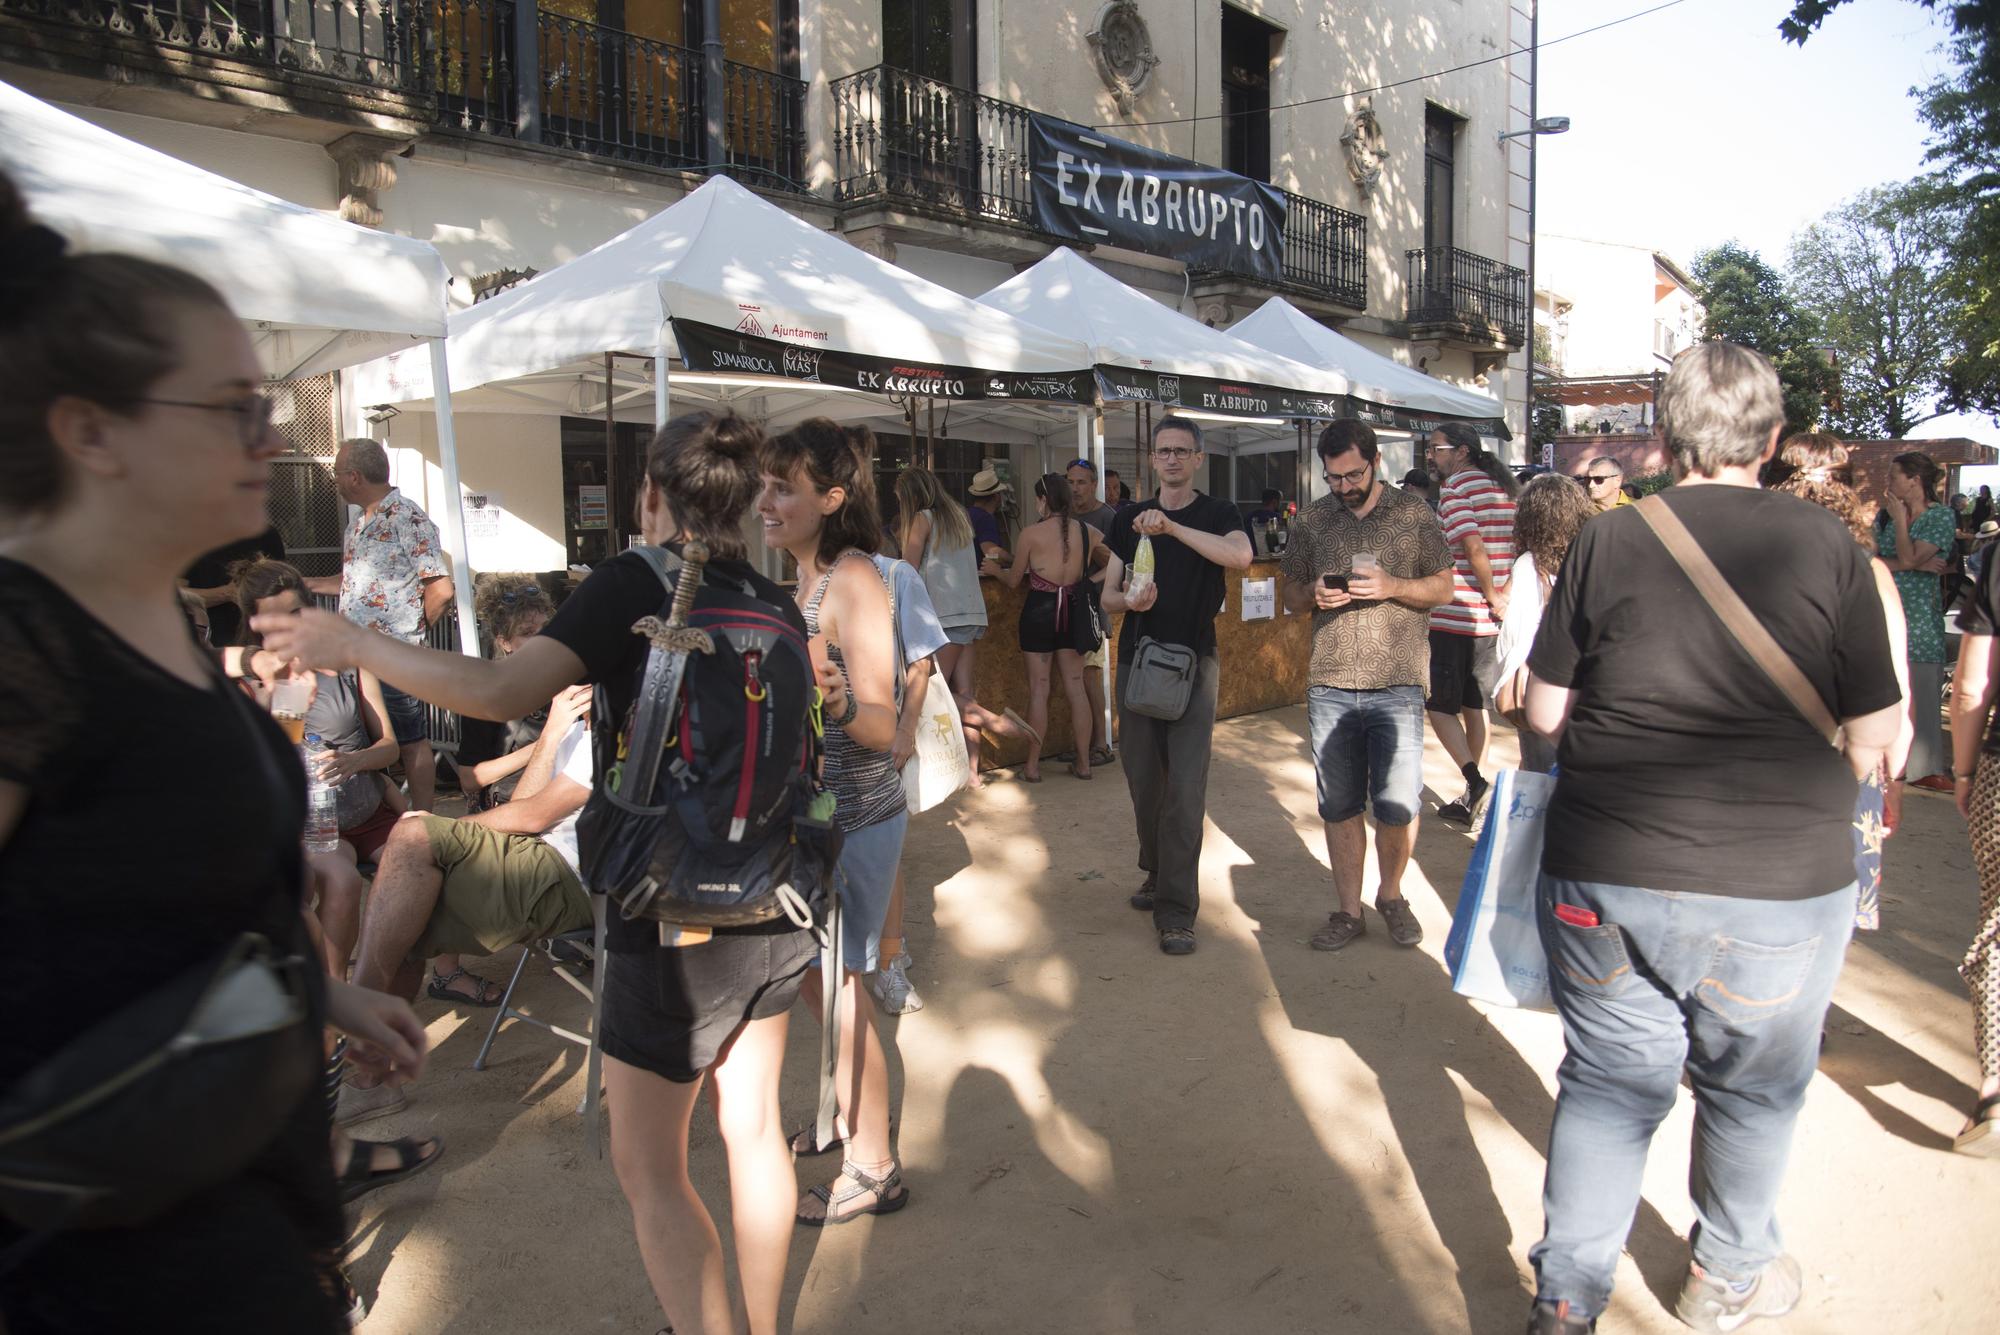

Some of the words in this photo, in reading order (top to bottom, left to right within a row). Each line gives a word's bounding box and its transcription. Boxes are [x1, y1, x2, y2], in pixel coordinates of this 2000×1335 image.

[1056, 150, 1105, 214] EX
[1117, 170, 1265, 251] ABRUPTO
[771, 324, 829, 341] Ajuntament
[712, 350, 777, 374] SUMARROCA
[784, 348, 818, 363] CASA
[784, 360, 812, 374] MAS
[890, 366, 946, 379] FESTIVAL
[857, 370, 880, 390] EX
[884, 376, 965, 396] ABRUPTO
[1159, 379, 1178, 390] CASA
[1203, 393, 1217, 407] EX
[1219, 398, 1268, 413] ABRUPTO
[697, 883, 726, 892] HIKING
